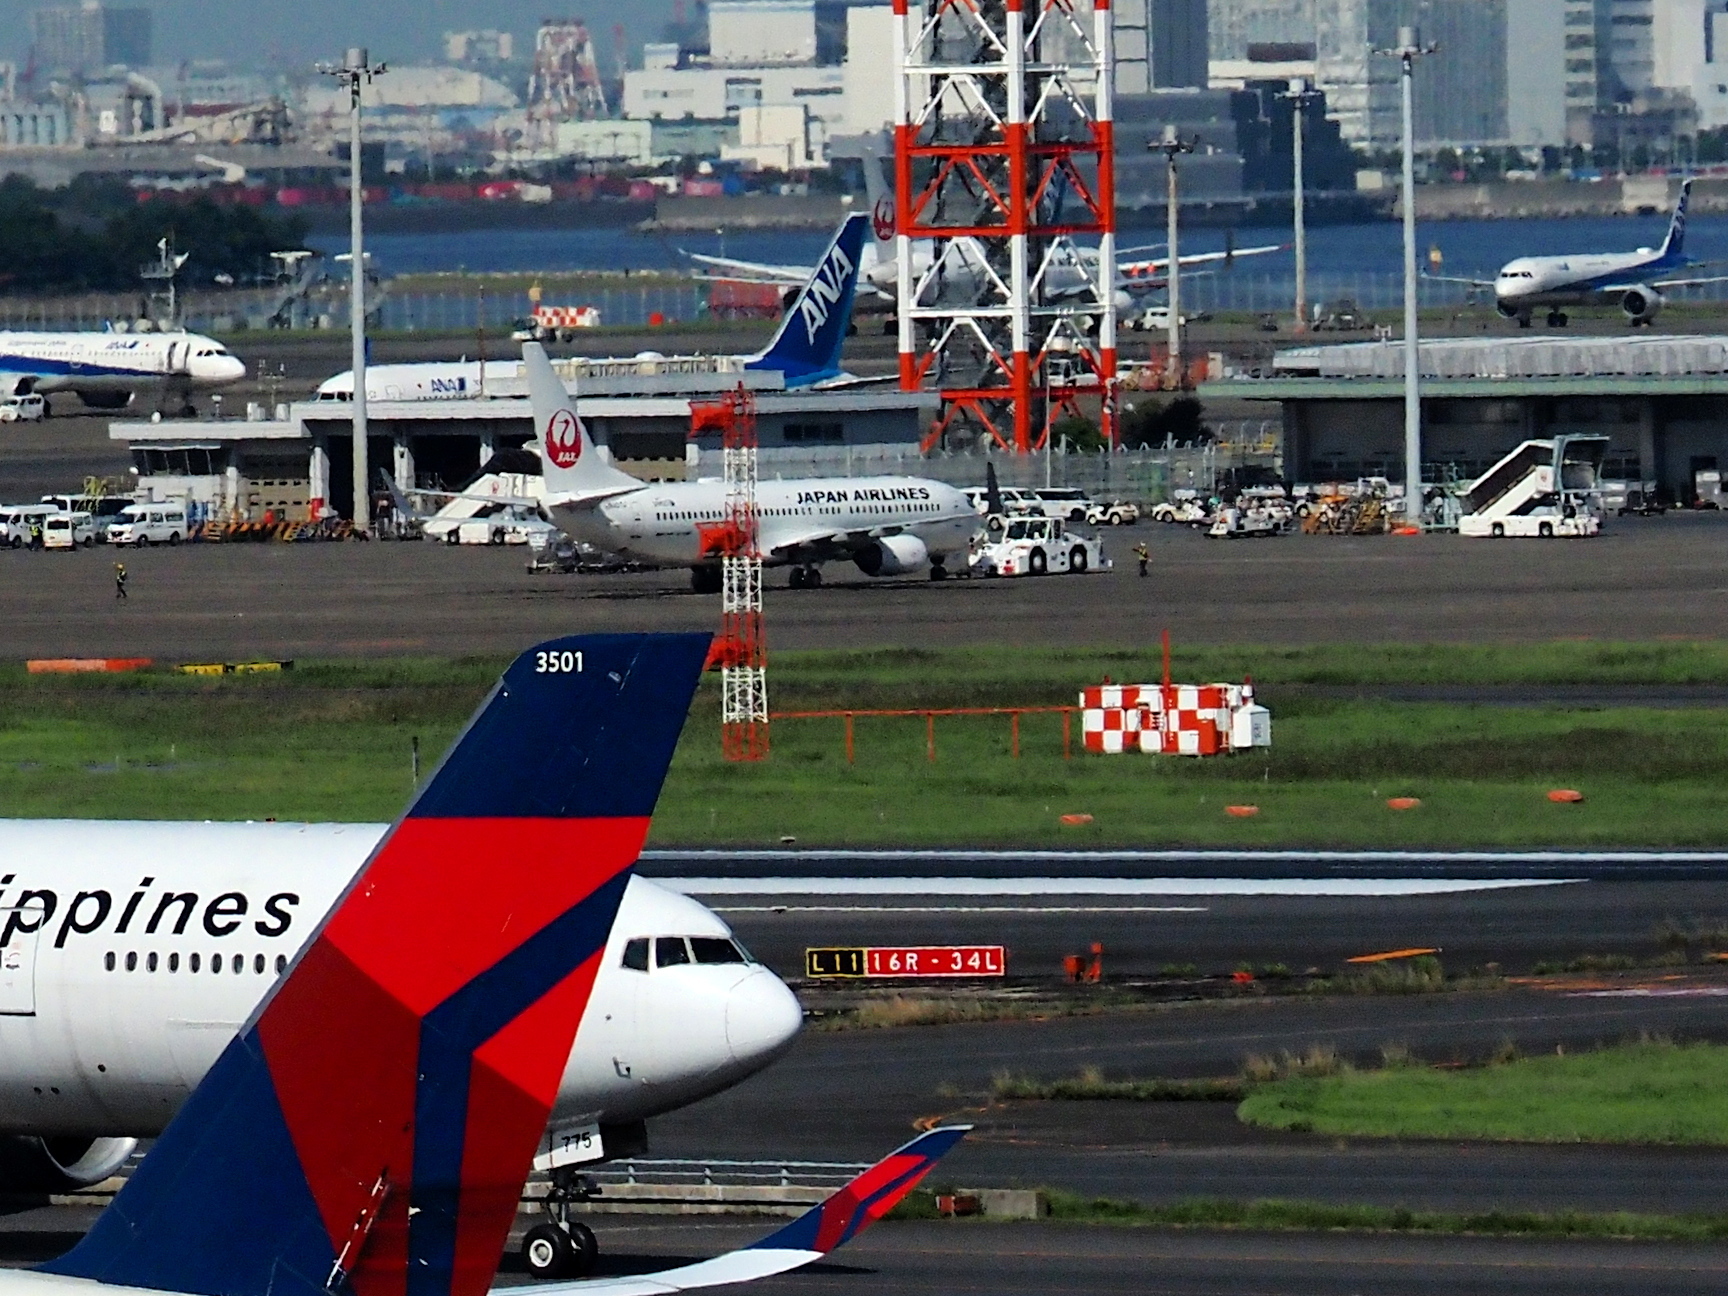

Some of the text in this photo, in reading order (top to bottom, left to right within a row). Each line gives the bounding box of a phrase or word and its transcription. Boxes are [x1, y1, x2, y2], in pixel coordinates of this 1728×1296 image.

[799, 245, 854, 346] ANA
[555, 452, 578, 463] JAL
[797, 487, 930, 505] JAPAN AIRLINES
[535, 650, 583, 673] 3501
[873, 952, 919, 971] 16R
[950, 951, 998, 971] 34L
[561, 1131, 592, 1153] 775
